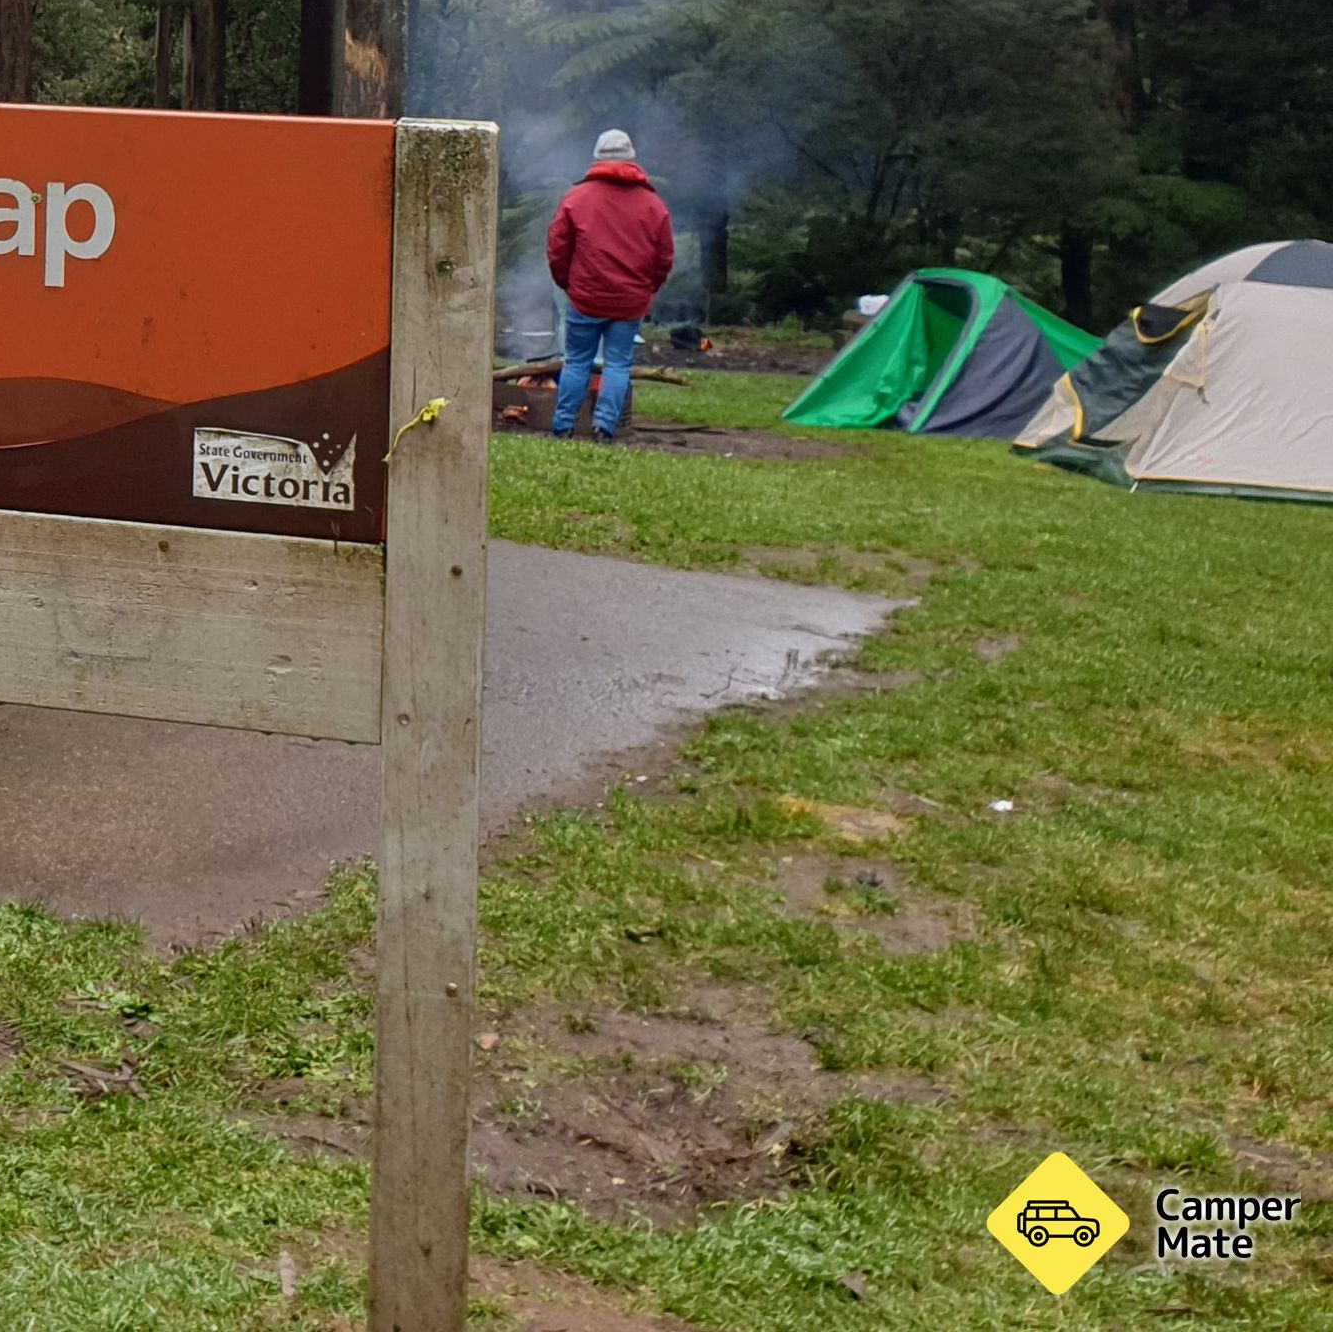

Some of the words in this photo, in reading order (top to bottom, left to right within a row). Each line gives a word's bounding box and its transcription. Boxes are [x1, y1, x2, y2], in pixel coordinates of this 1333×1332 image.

[199, 443, 230, 458] State
[233, 445, 308, 464] Government
[200, 461, 351, 504] Victoria
